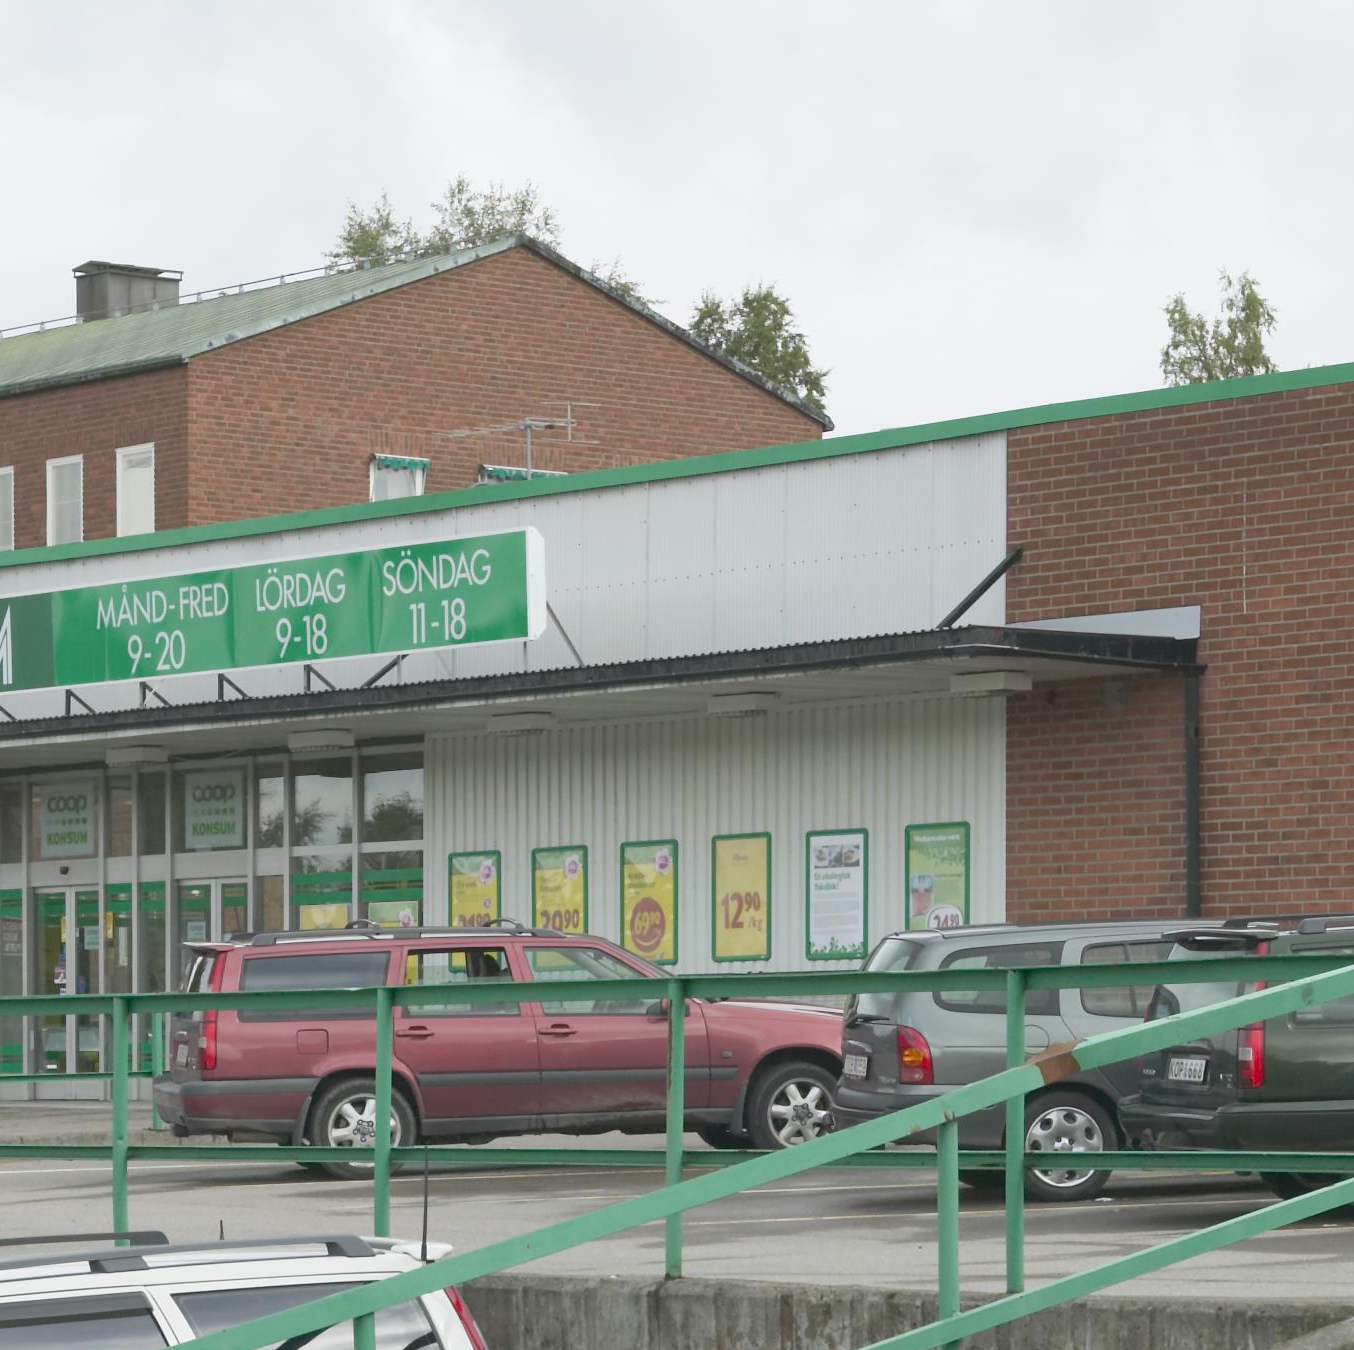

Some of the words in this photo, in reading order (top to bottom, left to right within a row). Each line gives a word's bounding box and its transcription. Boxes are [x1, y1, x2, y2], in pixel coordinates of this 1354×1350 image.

[255, 567, 346, 612] LÖRDAG
[382, 548, 492, 597] SÖNDAG
[276, 613, 329, 658] 9-18
[409, 598, 467, 645] 11-18
[127, 630, 186, 674] 9-20
